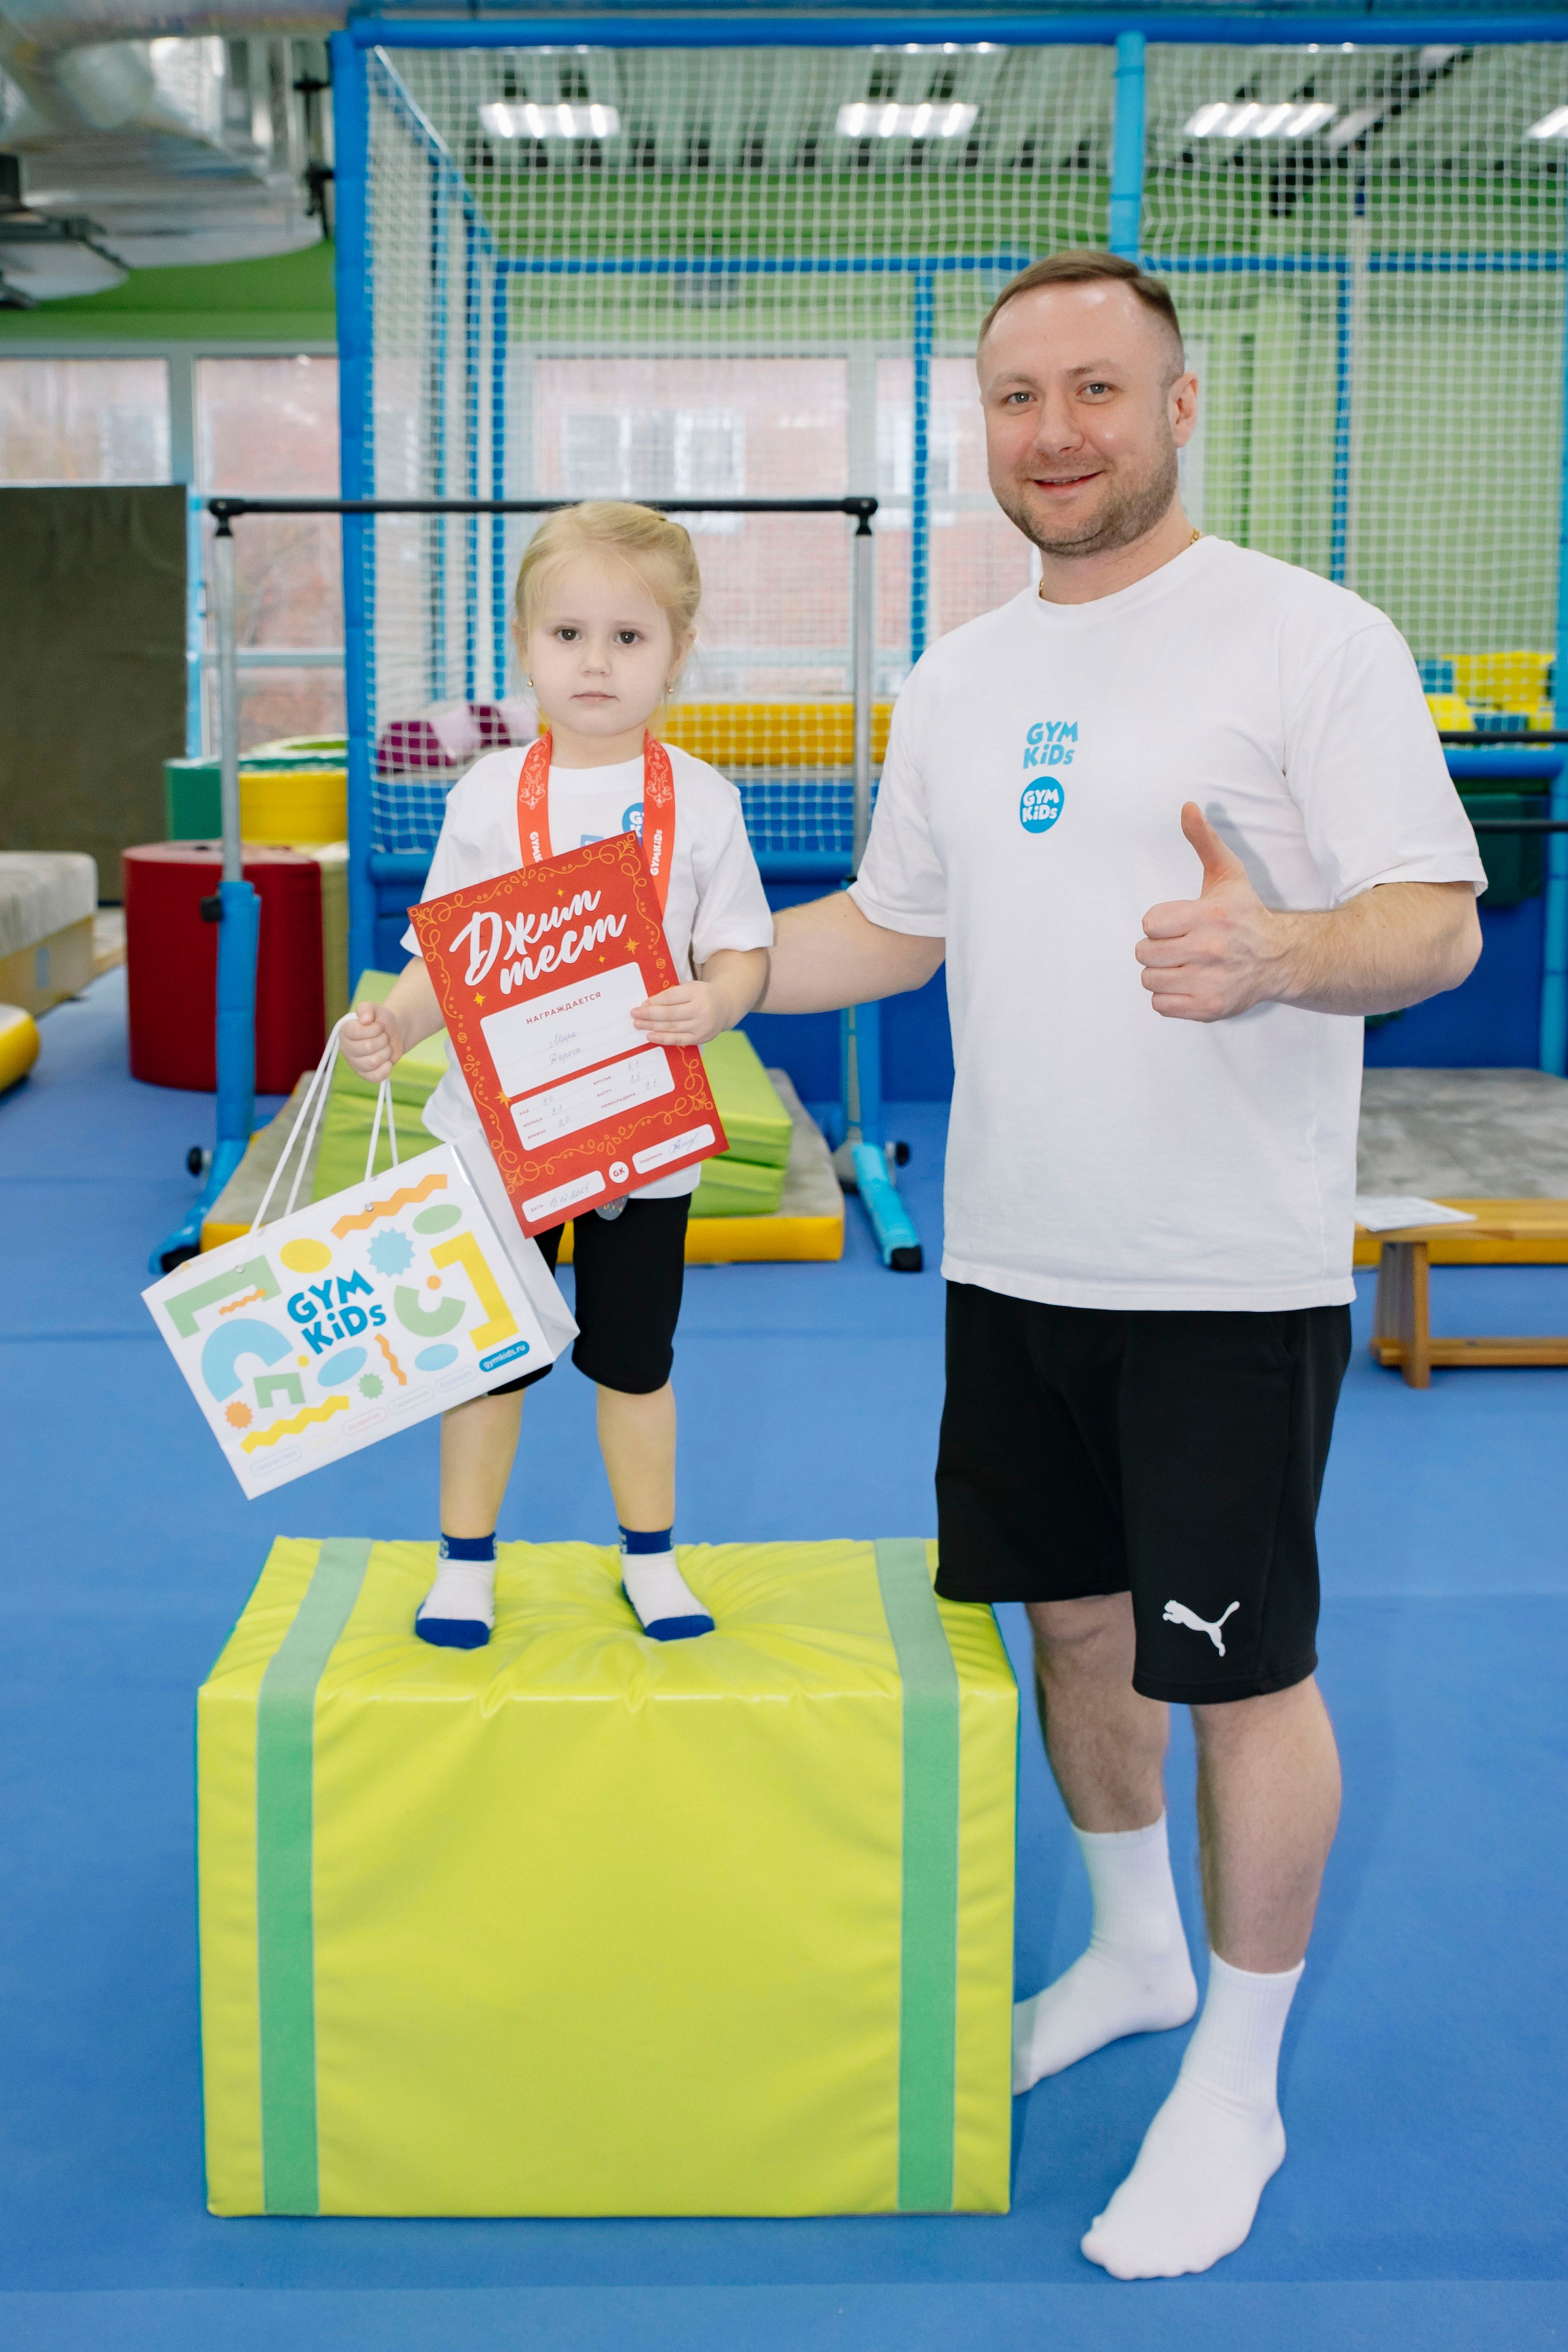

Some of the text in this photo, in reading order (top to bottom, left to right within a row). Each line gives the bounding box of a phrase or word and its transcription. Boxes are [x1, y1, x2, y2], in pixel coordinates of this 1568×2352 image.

[1026, 720, 1079, 745] GYM
[1022, 744, 1076, 769] KiDs
[1022, 788, 1060, 807] GYM
[1022, 804, 1058, 823] KiDs
[529, 831, 543, 864] GYMK
[499, 913, 628, 995] тест
[526, 991, 602, 1025] НАГРАЖДАЕТСЯ
[612, 1167, 625, 1177] GK
[287, 1268, 375, 1324] GYM
[301, 1304, 387, 1355] KiDs
[483, 1344, 526, 1370] gymkids.ru
